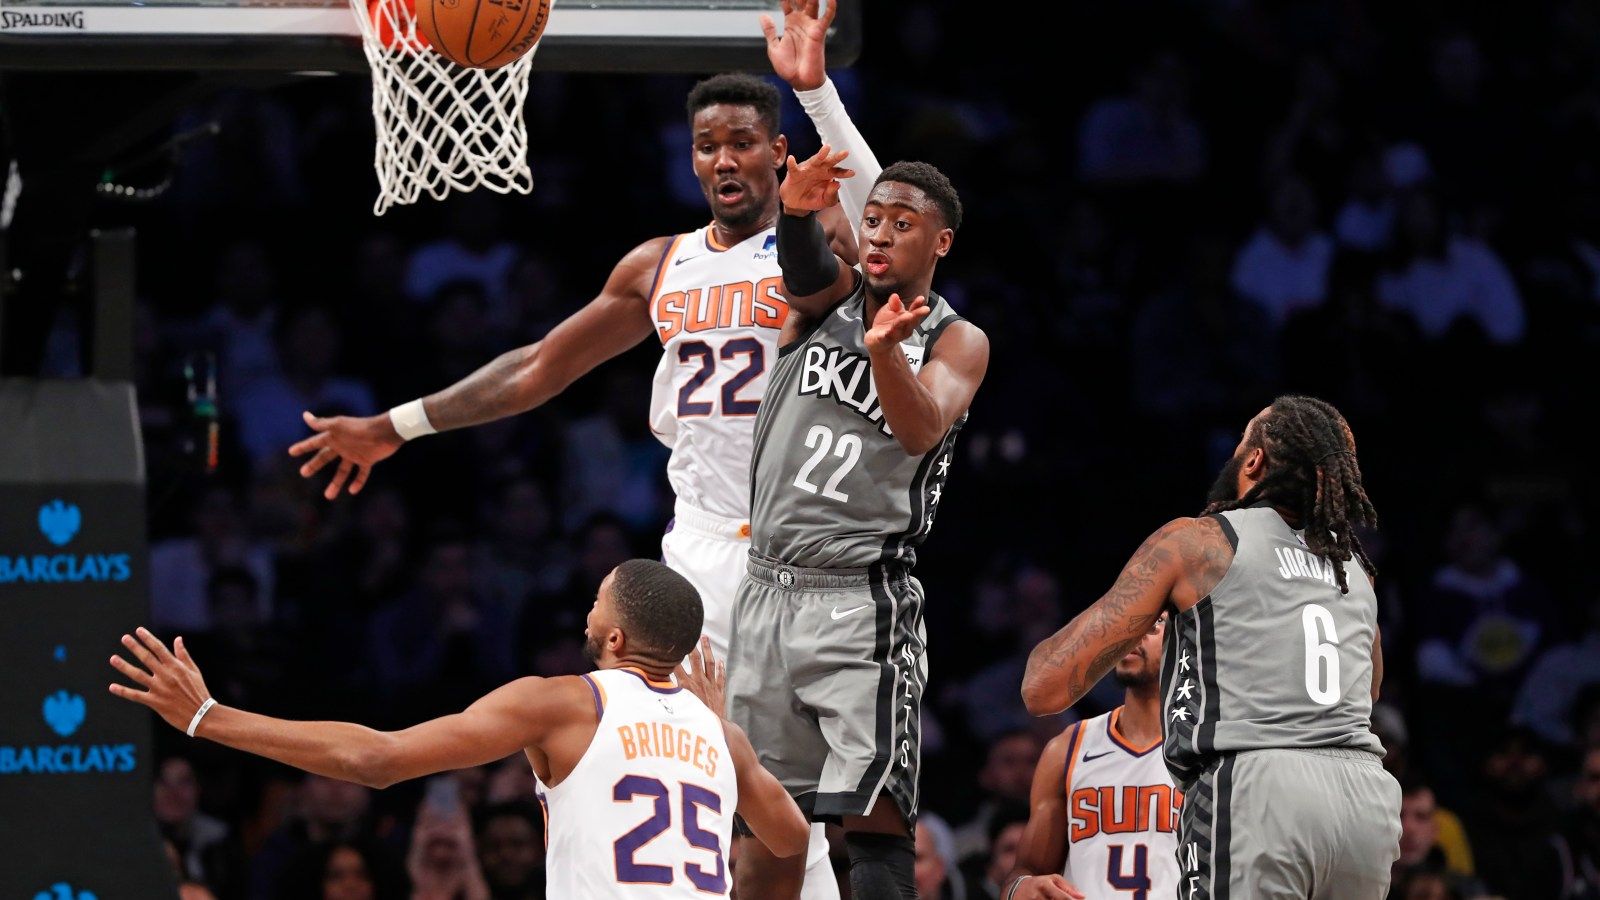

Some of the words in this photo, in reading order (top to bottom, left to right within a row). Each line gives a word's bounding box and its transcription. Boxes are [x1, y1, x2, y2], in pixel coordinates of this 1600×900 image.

[1, 11, 84, 29] SPALDING
[509, 0, 548, 52] LDING
[657, 276, 788, 345] SUNS
[677, 337, 765, 418] 22
[793, 425, 863, 503] 22
[0, 553, 131, 582] BARCLAYS
[1275, 547, 1350, 591] JORDA
[1302, 604, 1341, 705] 6
[0, 744, 136, 773] BARCLAYS
[617, 722, 719, 778] BRIDGES
[612, 774, 728, 895] 25
[1107, 844, 1152, 900] 4
